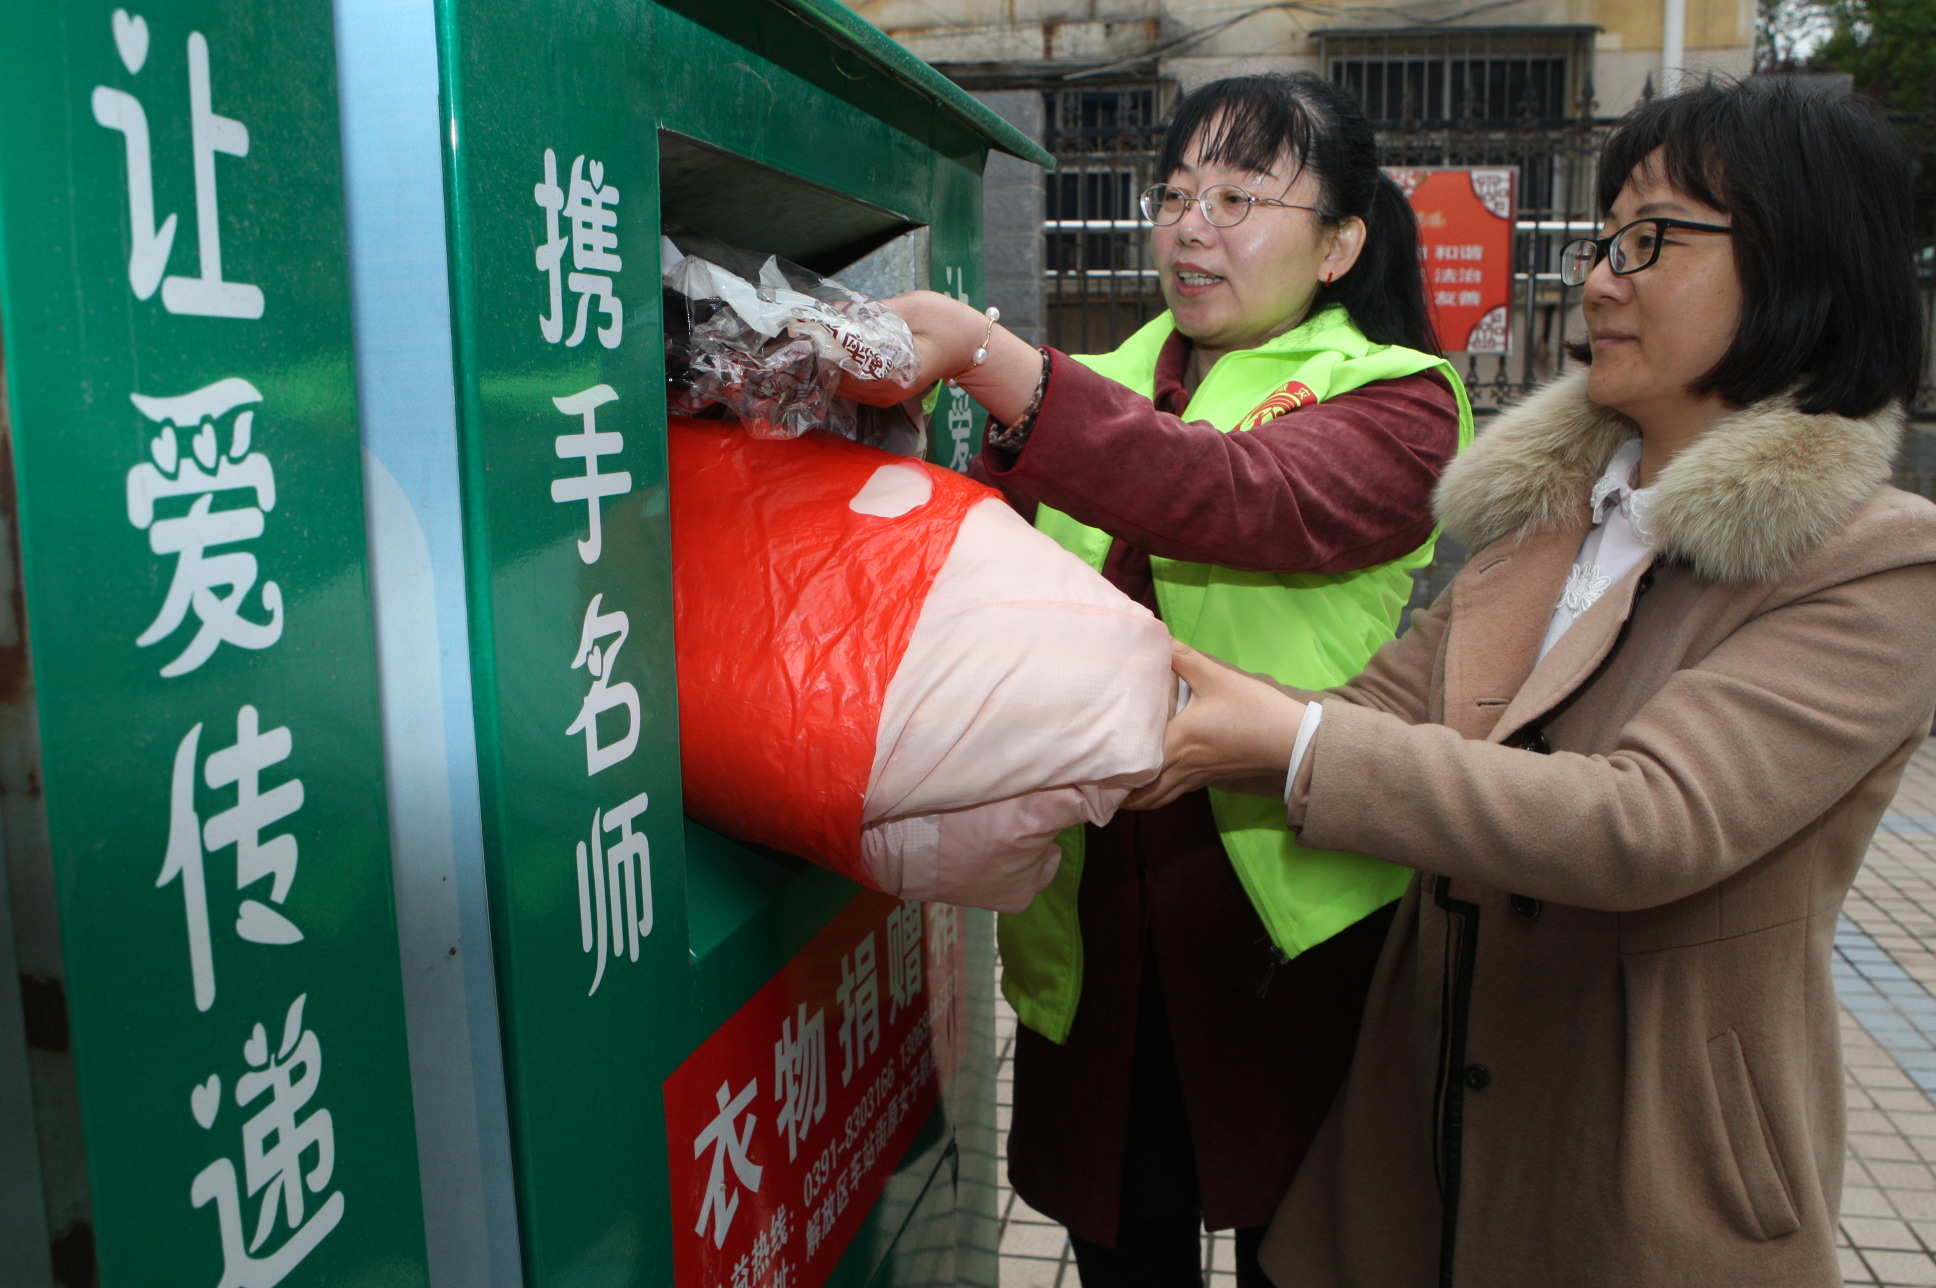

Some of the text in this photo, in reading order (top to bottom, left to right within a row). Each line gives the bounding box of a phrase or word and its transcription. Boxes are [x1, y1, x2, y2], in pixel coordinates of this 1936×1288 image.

[91, 7, 345, 1288] 让爱传递
[533, 147, 654, 997] 携手名师
[803, 1060, 895, 1207] 0391-8303166
